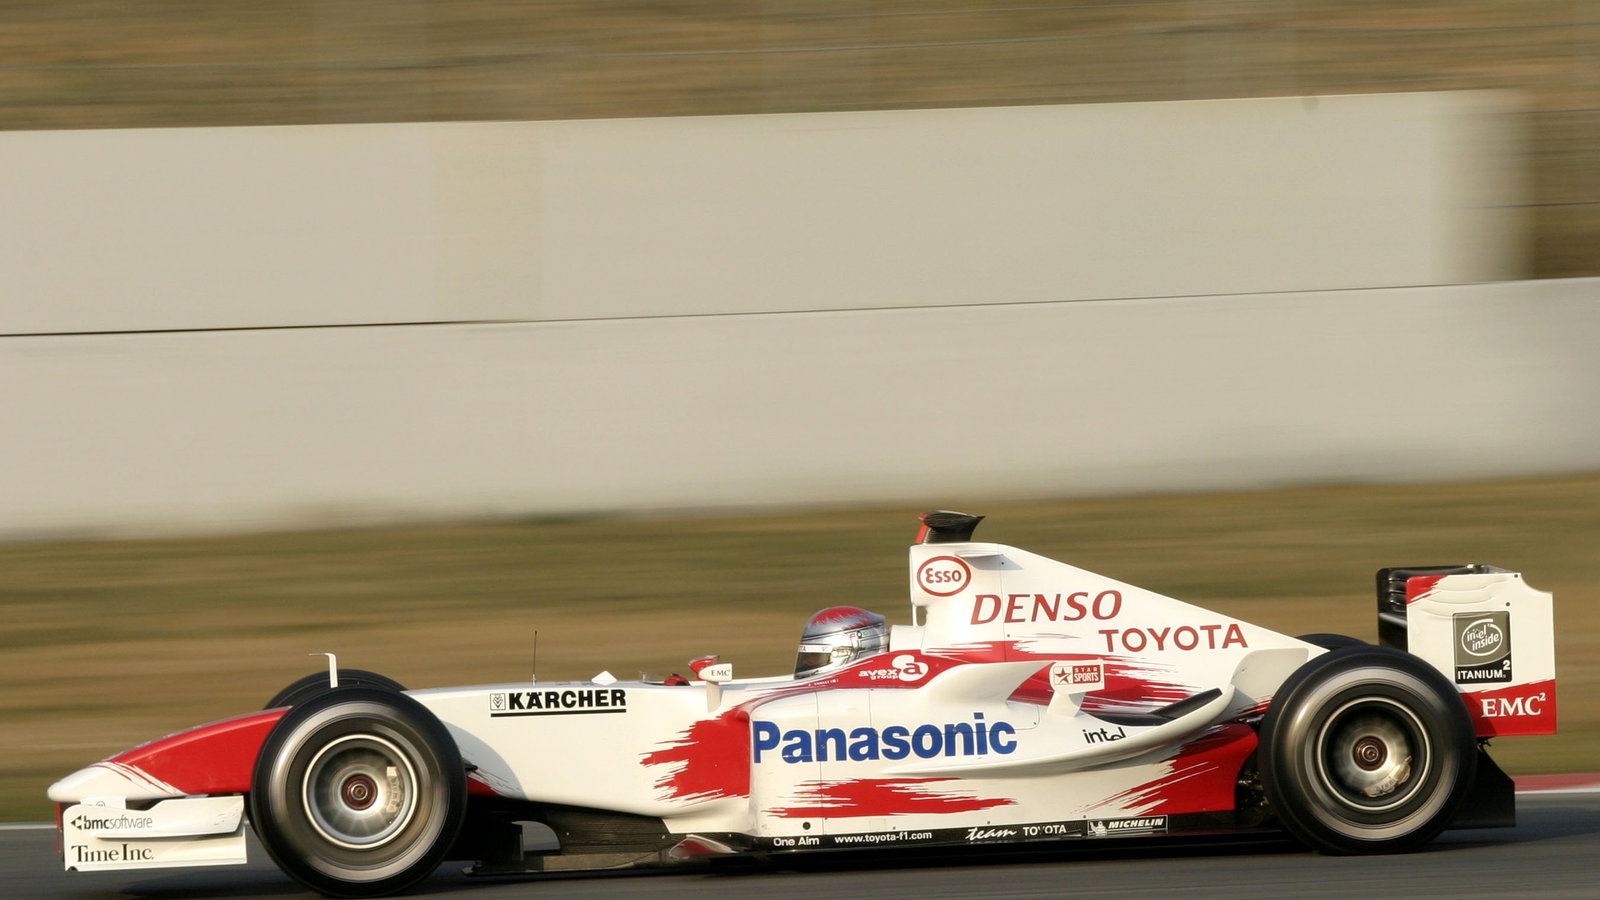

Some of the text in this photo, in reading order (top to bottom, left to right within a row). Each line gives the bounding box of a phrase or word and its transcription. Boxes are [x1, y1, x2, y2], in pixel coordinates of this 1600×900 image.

[970, 589, 1123, 625] DENSO
[1098, 623, 1248, 653] TOYOTA
[1472, 633, 1500, 651] inside
[858, 668, 898, 677] avex
[1073, 672, 1099, 682] SPORTS
[508, 689, 627, 710] KÄRCHER
[753, 712, 1017, 764] Panasonic
[1082, 726, 1127, 744] intel
[1107, 818, 1165, 830] MICHELIN
[773, 836, 820, 847] One Aim
[834, 831, 933, 844] www.toyota-f1.com
[965, 826, 1018, 841] team
[70, 843, 154, 862] Time Inc.
